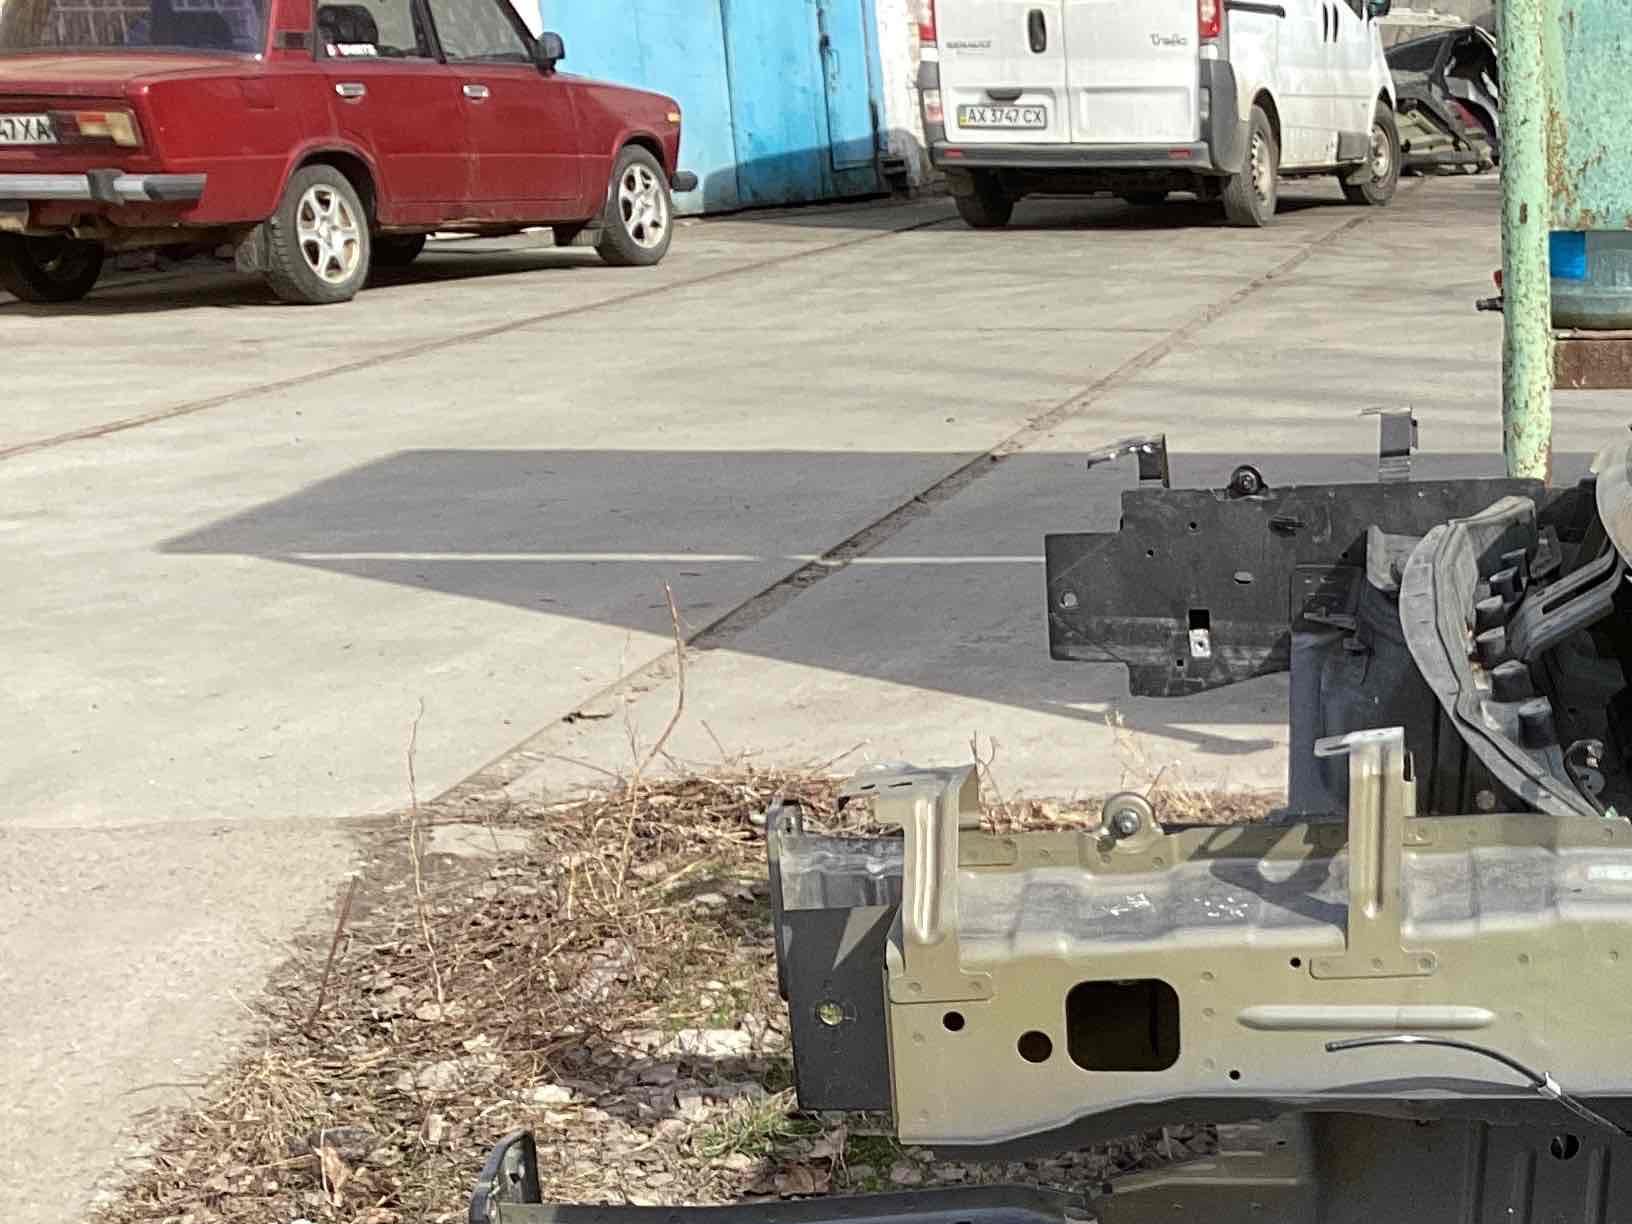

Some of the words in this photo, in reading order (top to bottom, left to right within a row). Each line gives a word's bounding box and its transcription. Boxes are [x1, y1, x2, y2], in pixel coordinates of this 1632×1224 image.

[968, 108, 986, 123] AX
[991, 108, 1020, 123] 3747
[1023, 108, 1042, 123] CX
